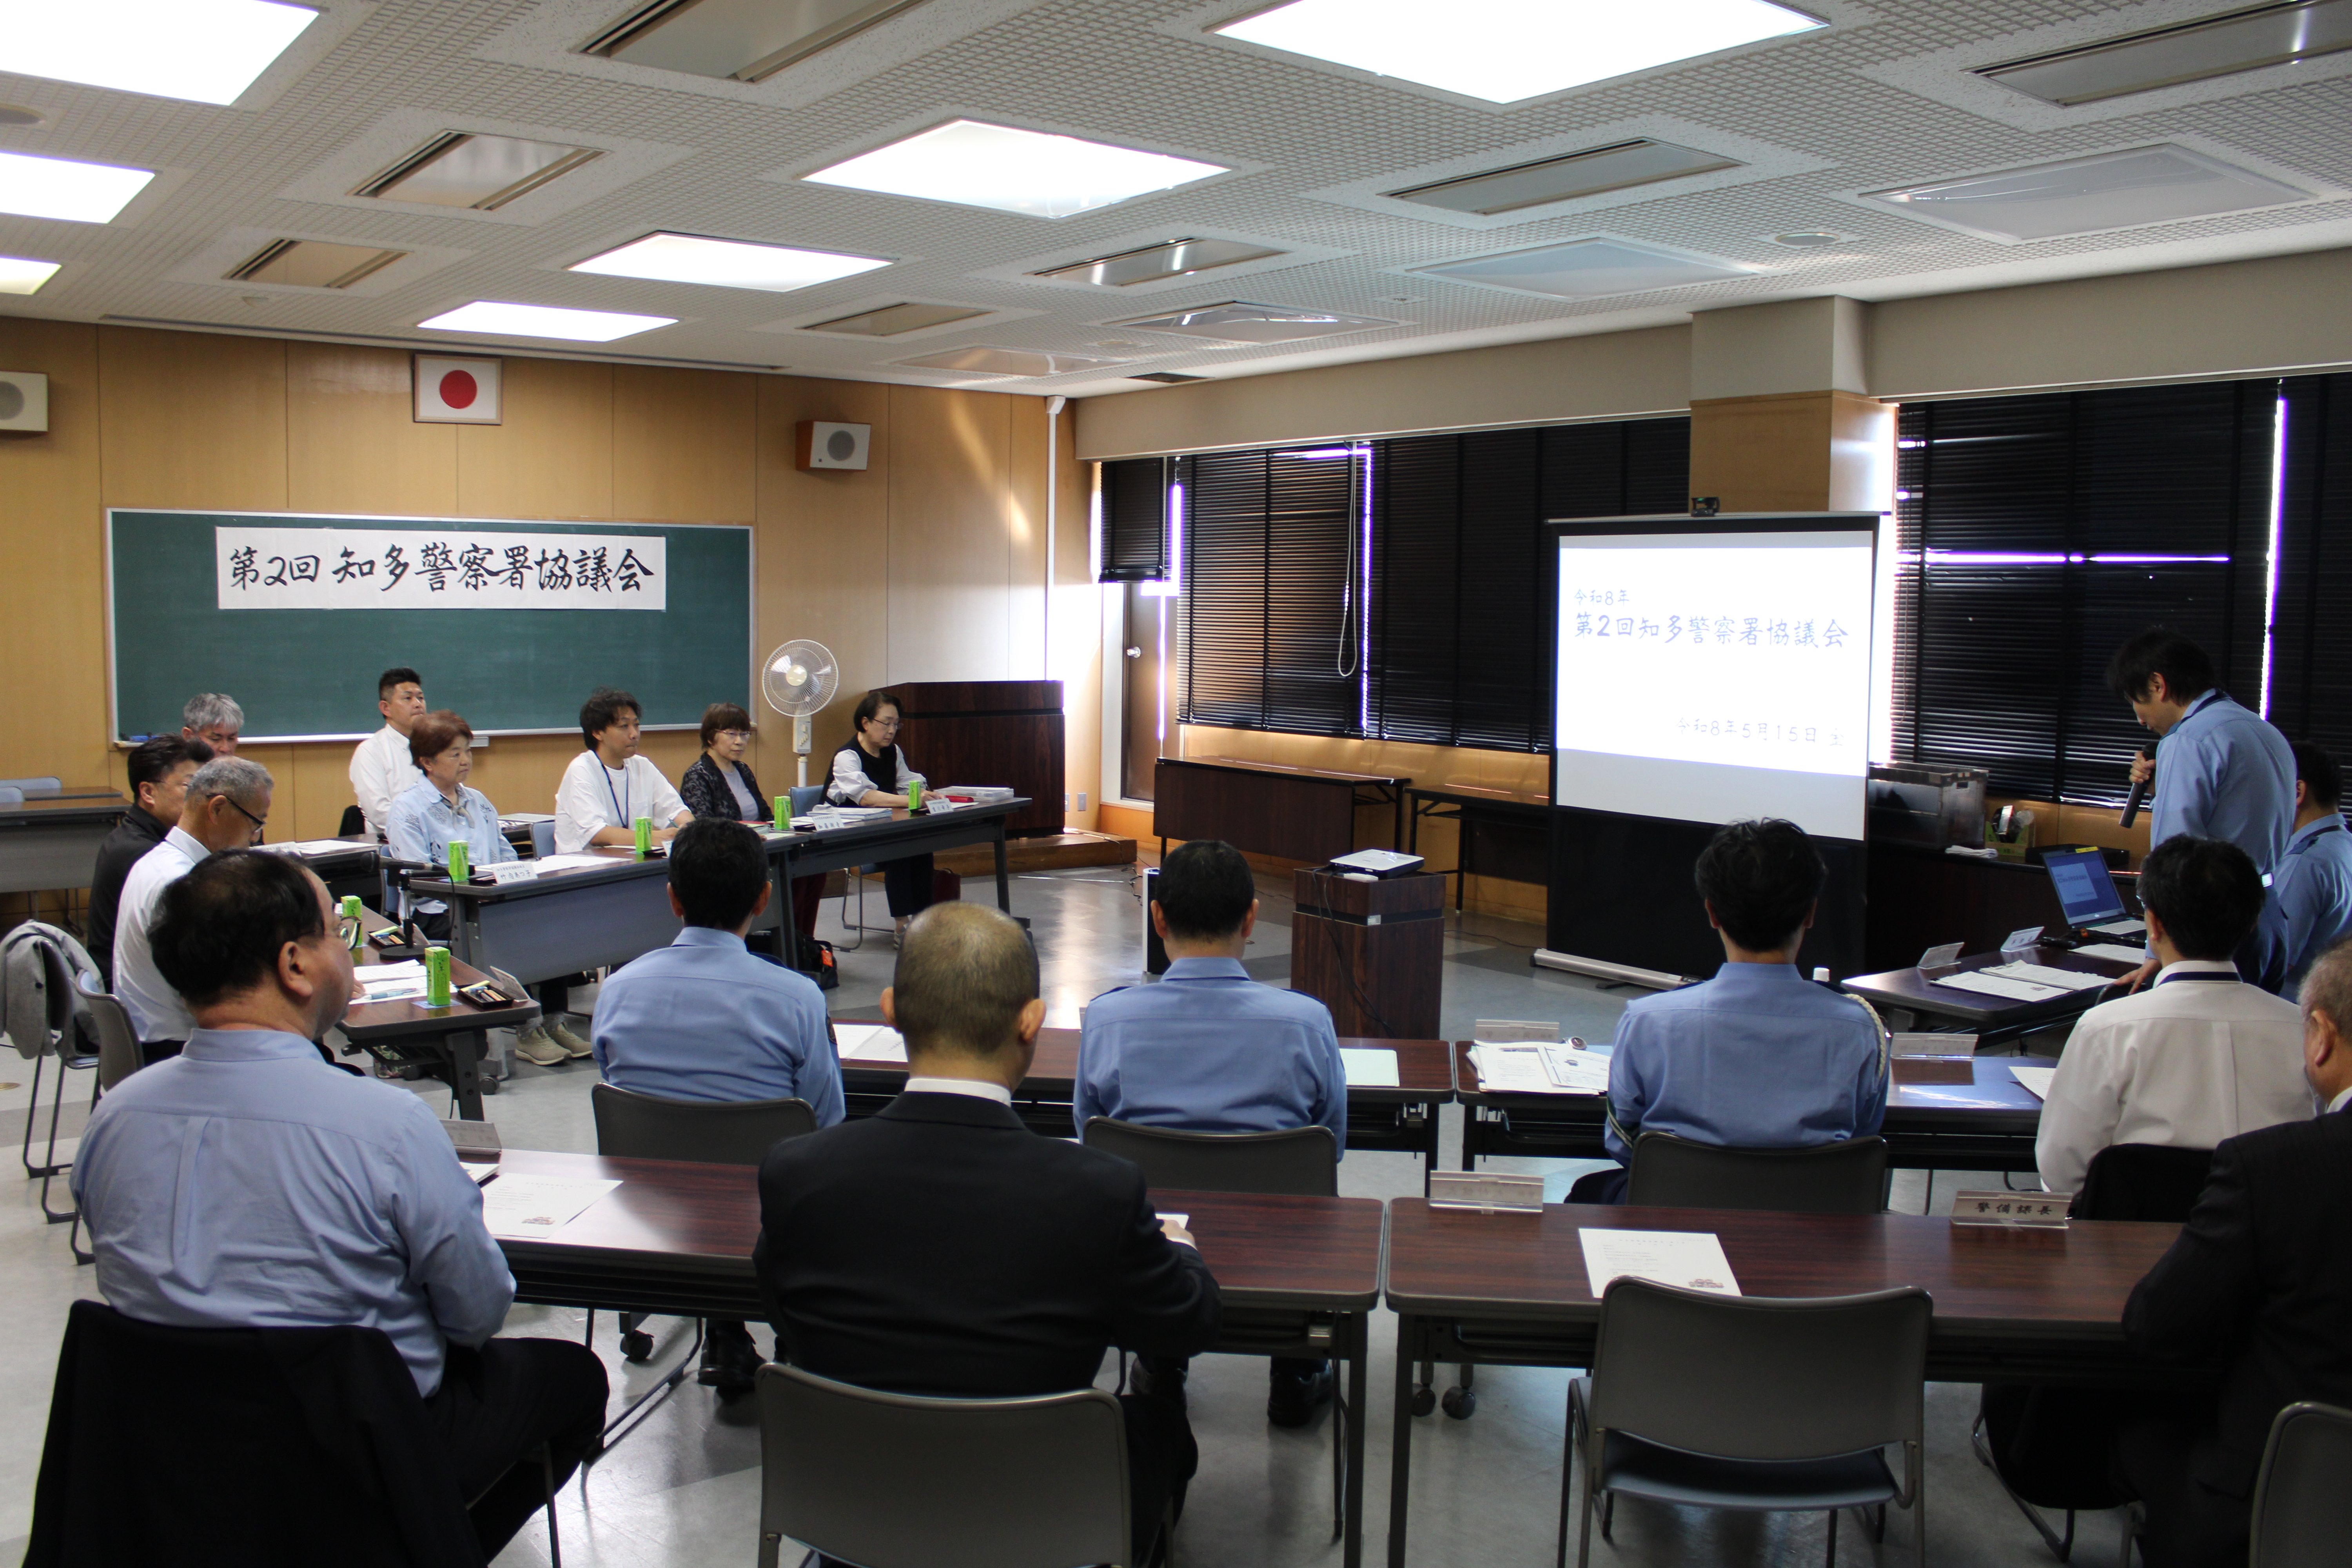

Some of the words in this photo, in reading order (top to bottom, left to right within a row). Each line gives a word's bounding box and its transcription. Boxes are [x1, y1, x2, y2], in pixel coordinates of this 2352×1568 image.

[230, 543, 654, 592] 第2回知多警察署協議会
[1573, 588, 1630, 606] 令和8年
[1574, 611, 1849, 648] 第2回知多警察署協議会
[1975, 1202, 2052, 1215] 警備課長
